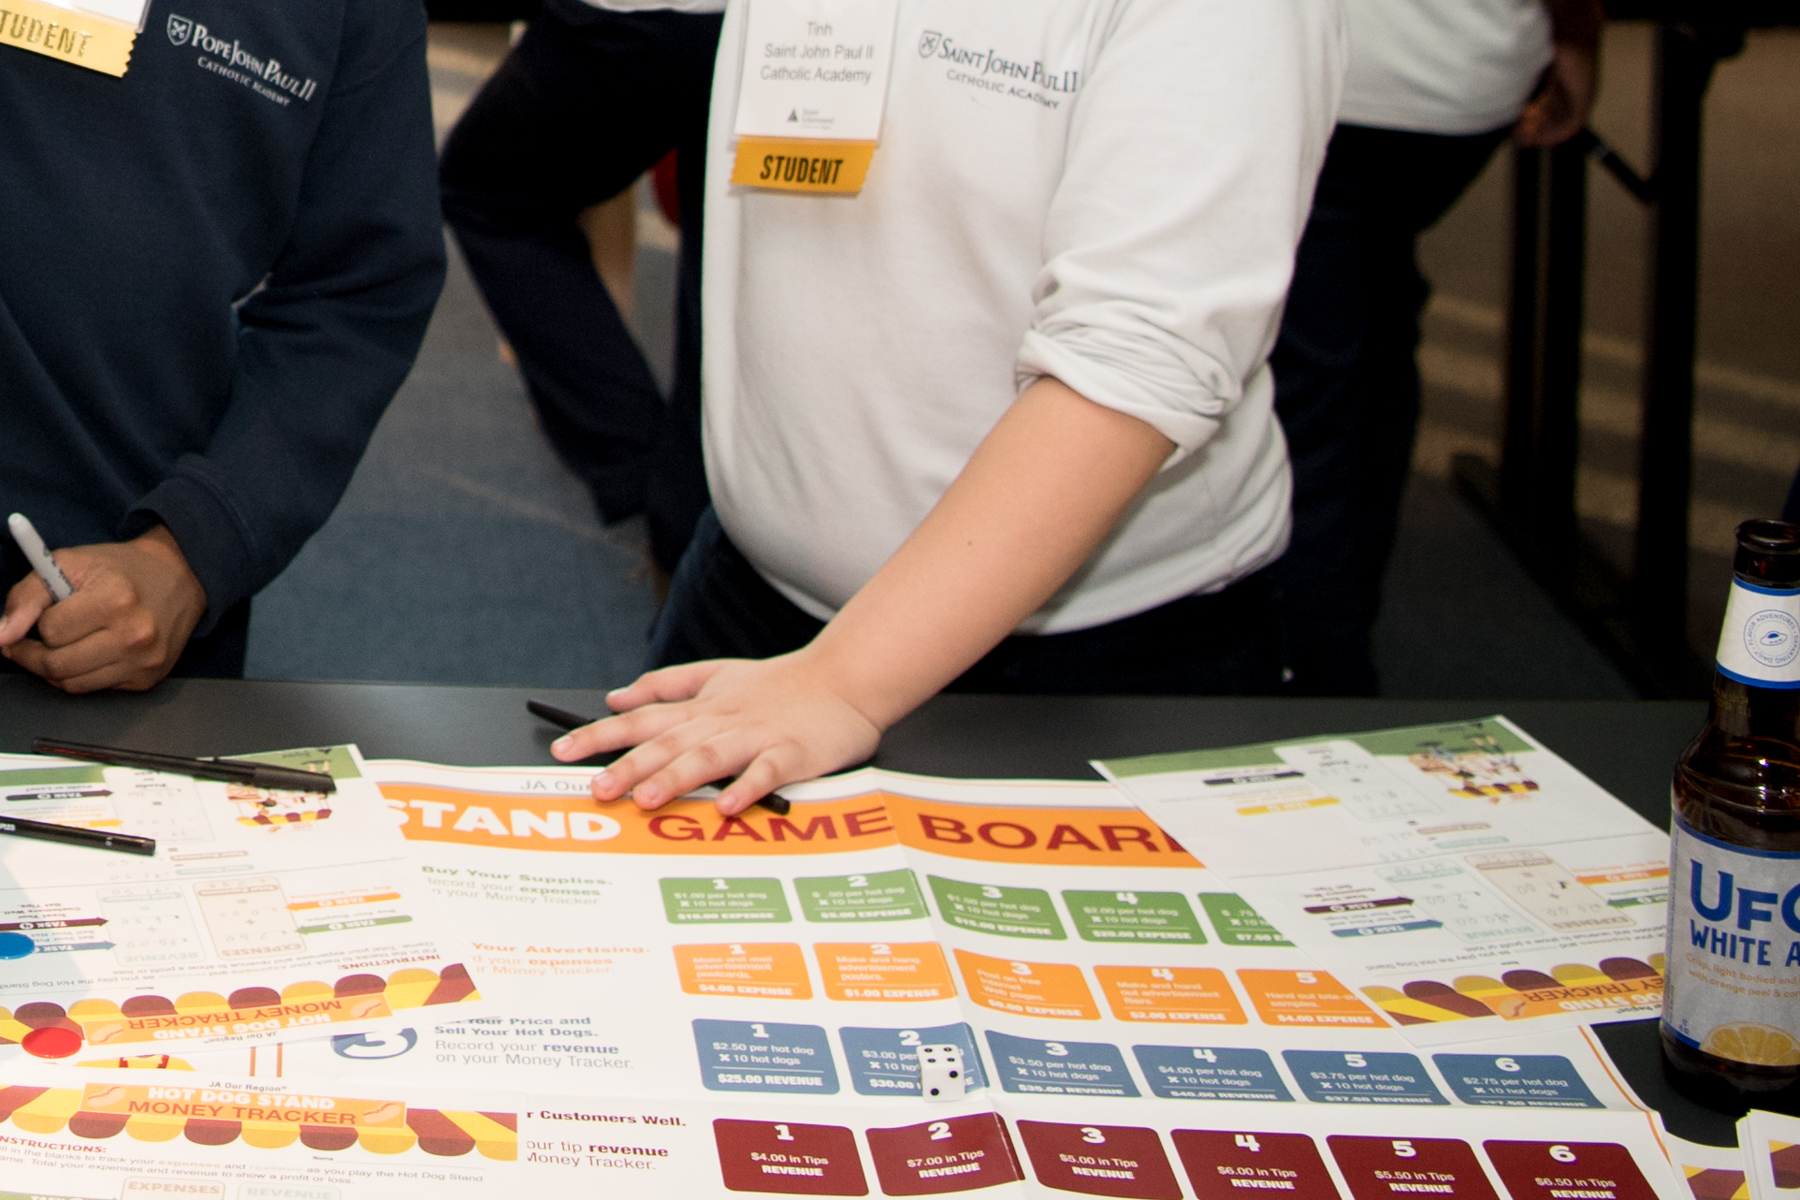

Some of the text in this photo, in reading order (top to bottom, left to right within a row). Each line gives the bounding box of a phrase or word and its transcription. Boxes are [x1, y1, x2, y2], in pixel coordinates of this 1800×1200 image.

[806, 21, 833, 36] Tinh
[764, 43, 797, 58] Saint
[800, 44, 830, 59] John
[834, 45, 862, 60] Paul
[760, 66, 872, 85] Catholic Academy
[760, 155, 844, 185] STUDENT
[520, 780, 547, 791] JA
[386, 798, 622, 842] STAND
[648, 804, 897, 842] GAME
[422, 866, 459, 876] Buy
[466, 868, 512, 880] Your
[472, 942, 518, 952] Your
[1690, 918, 1771, 967] WHITE
[1713, 962, 1738, 979] light
[1739, 970, 1777, 985] bodied
[1522, 979, 1632, 1003] TRACKER
[1709, 978, 1745, 994] orange
[1748, 986, 1771, 998] peel
[127, 1000, 343, 1030] MONEY TRACKER
[510, 1017, 591, 1026] Price and
[152, 1012, 332, 1042] HOT DOG STAND
[434, 1025, 599, 1039] Sell Your Hot Dogs.
[750, 1023, 770, 1038] 1
[435, 1039, 619, 1055] Record your revenue
[713, 1042, 815, 1056] $2.50 per hot dog
[435, 1053, 634, 1069] on your Money Tracker.
[733, 1054, 801, 1066] 10 hot dogs
[718, 1074, 823, 1086] $25.00 REVENUE
[148, 1086, 335, 1110] HOT DOG STAND
[127, 1100, 357, 1124] MONEY TRACKER
[540, 1110, 687, 1127] Customers Well.
[774, 1125, 794, 1141] 1
[928, 1122, 952, 1141] 2
[1080, 1127, 1105, 1144] 3
[561, 1141, 669, 1157] tip revenue
[1235, 1134, 1260, 1152] 4
[751, 1152, 829, 1165] $4.00 in Tips
[907, 1149, 985, 1168] $7.00 Tips
[1059, 1154, 1138, 1168] $5.00 Tips
[1549, 1144, 1577, 1163] 6
[585, 1155, 657, 1170] Tracker.
[761, 1164, 824, 1177] REVENUE
[918, 1162, 981, 1179] REVENUE
[1072, 1166, 1135, 1180] REVENUE
[1217, 1165, 1297, 1179] $6.00 Tips
[127, 1180, 220, 1195] EXPENSES
[1230, 1178, 1295, 1191] REVENUE
[1535, 1177, 1616, 1189] $6.50 Tips
